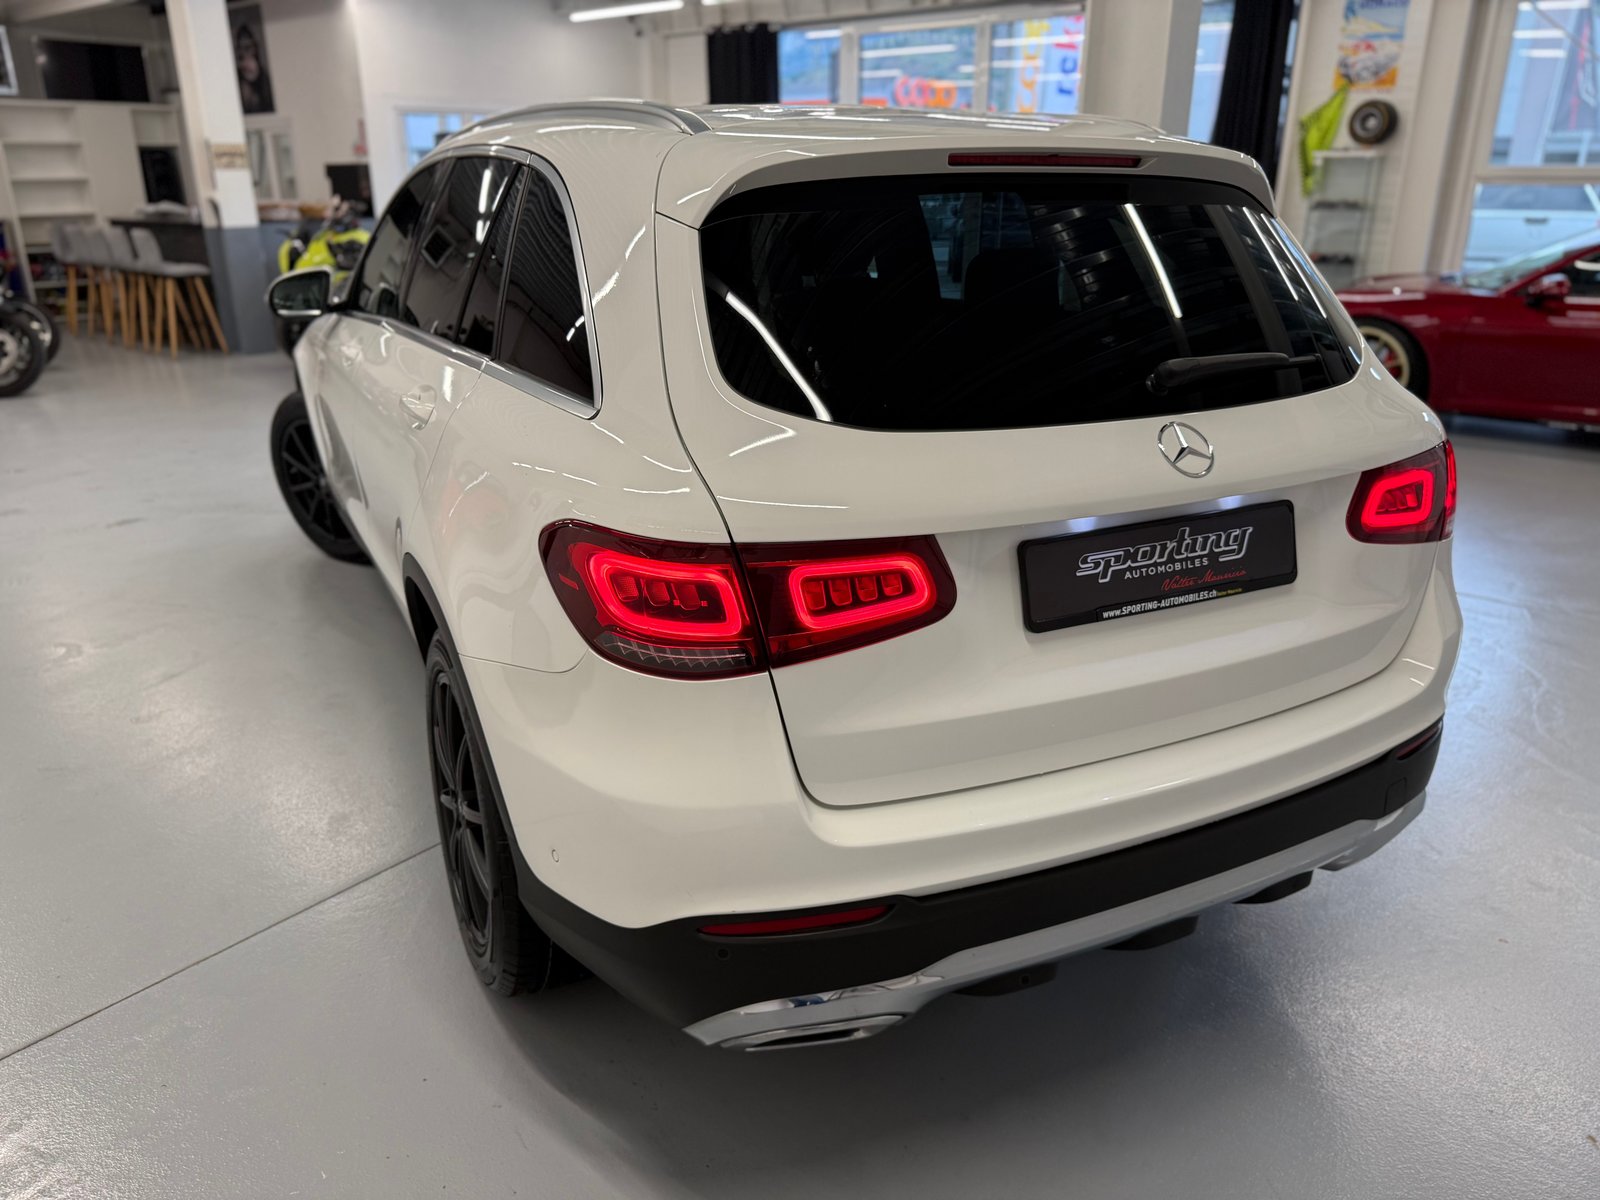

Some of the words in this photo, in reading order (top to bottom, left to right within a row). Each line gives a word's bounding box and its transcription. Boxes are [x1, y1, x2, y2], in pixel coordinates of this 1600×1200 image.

[1076, 526, 1253, 583] sporting
[1124, 557, 1209, 580] AUTOMOBILES
[1102, 589, 1217, 619] www.SPORTING-AUTOMOBILES.ch
